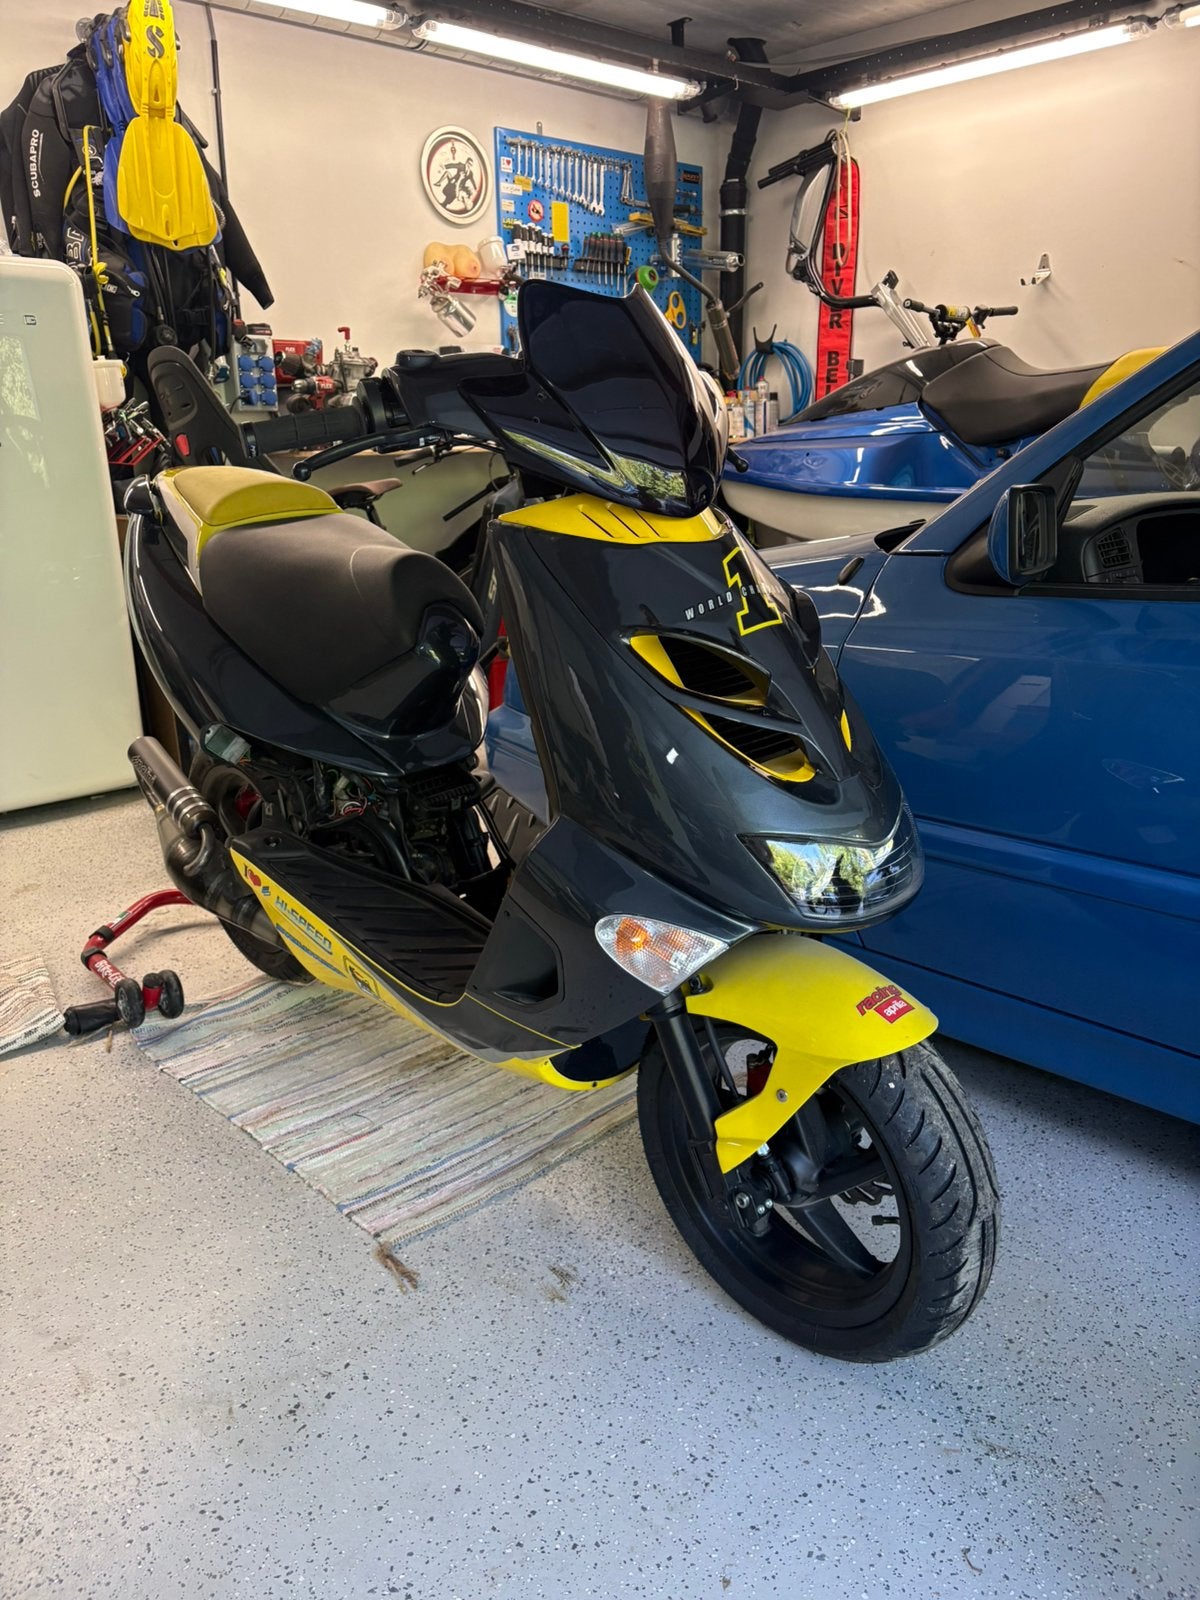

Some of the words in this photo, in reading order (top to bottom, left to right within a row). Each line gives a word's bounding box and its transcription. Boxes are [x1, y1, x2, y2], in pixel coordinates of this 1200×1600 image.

[29, 129, 41, 198] SCUBAPRO
[829, 242, 846, 330] DIVR
[684, 591, 733, 621] WORLD
[856, 985, 902, 1016] racing
[883, 1000, 907, 1016] aprilia
